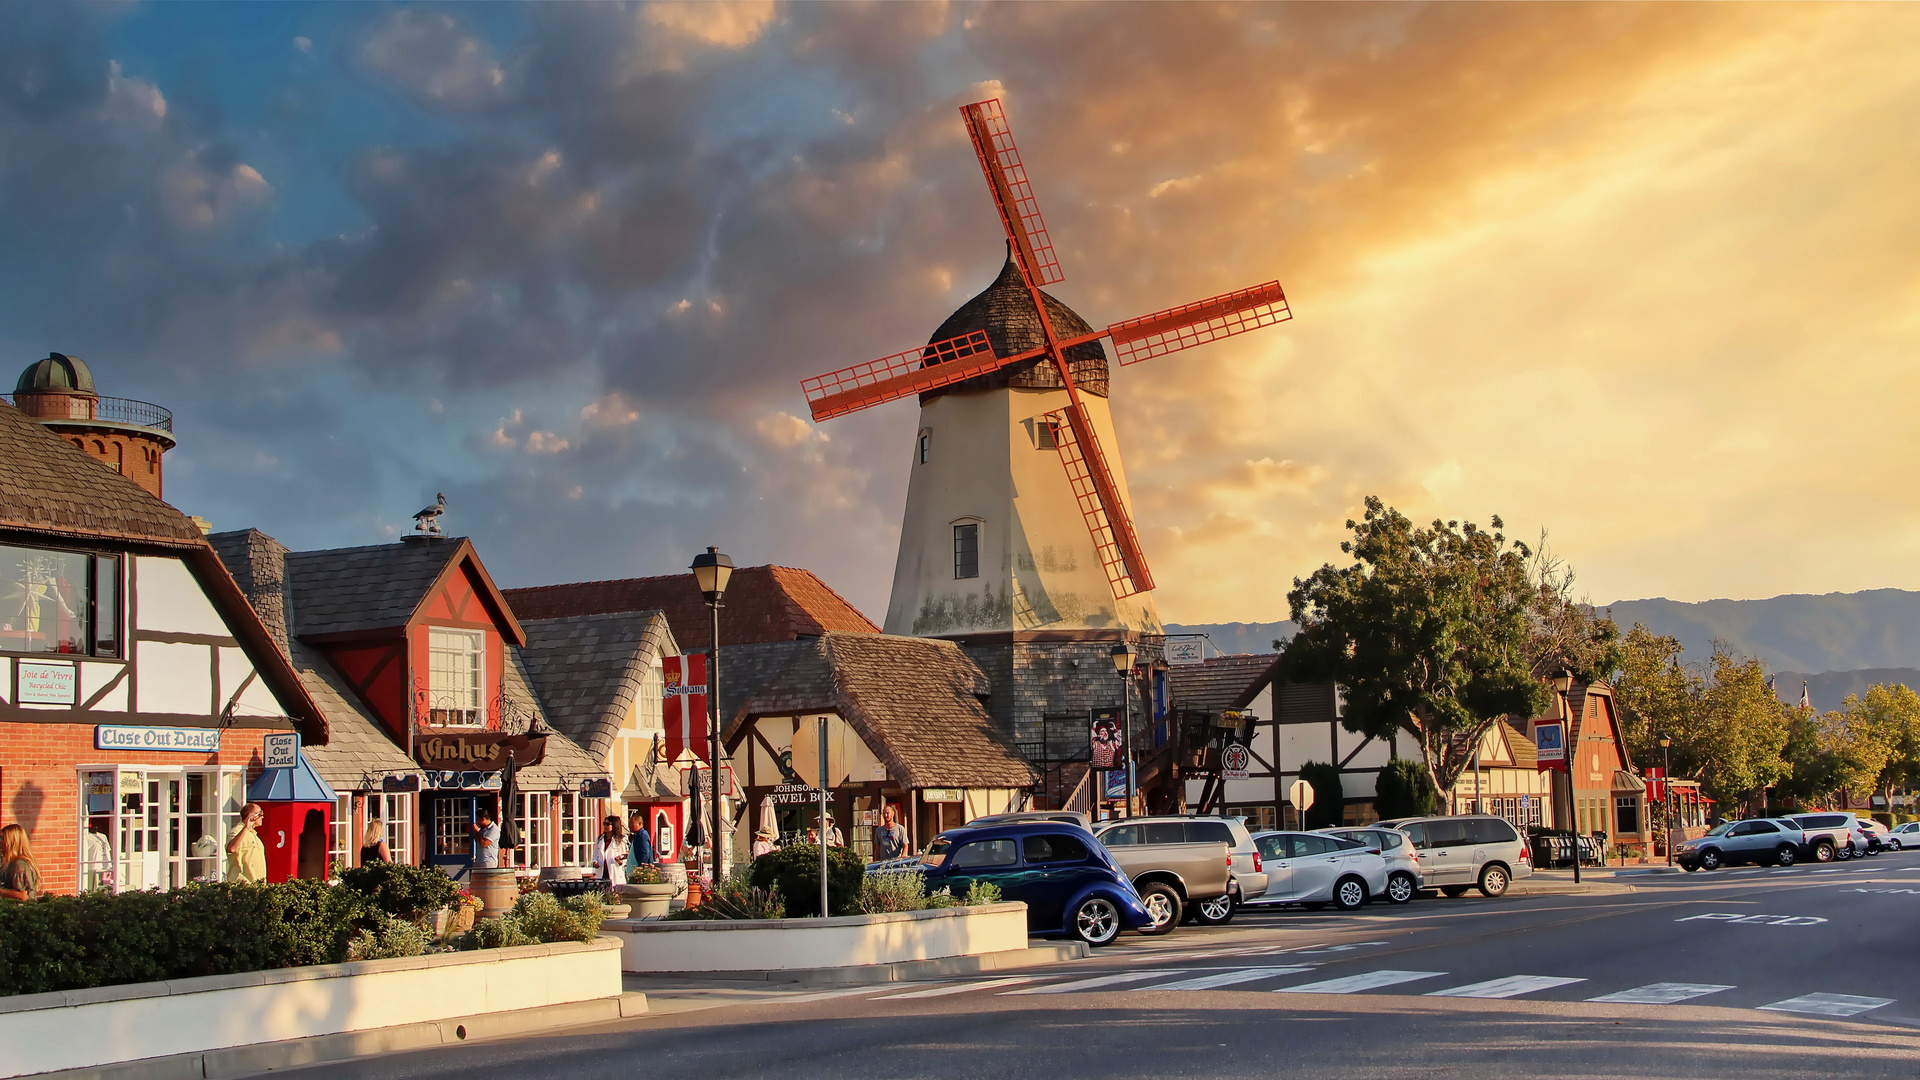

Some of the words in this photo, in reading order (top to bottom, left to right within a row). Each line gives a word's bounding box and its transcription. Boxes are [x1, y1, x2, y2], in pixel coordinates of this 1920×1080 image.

[22, 670, 38, 680] Joie
[40, 670, 49, 679] de
[51, 670, 73, 681] Vivre
[29, 682, 54, 690] Recycled
[665, 682, 706, 698] Solvang
[102, 729, 141, 745] Close
[144, 730, 171, 745] Out
[174, 730, 219, 748] Deals!
[270, 737, 292, 746] Close
[273, 746, 289, 755] Out
[420, 737, 501, 764] Vinhus
[268, 755, 294, 766] Deals!
[766, 793, 806, 804] EWEL
[1674, 912, 1829, 926] PED
